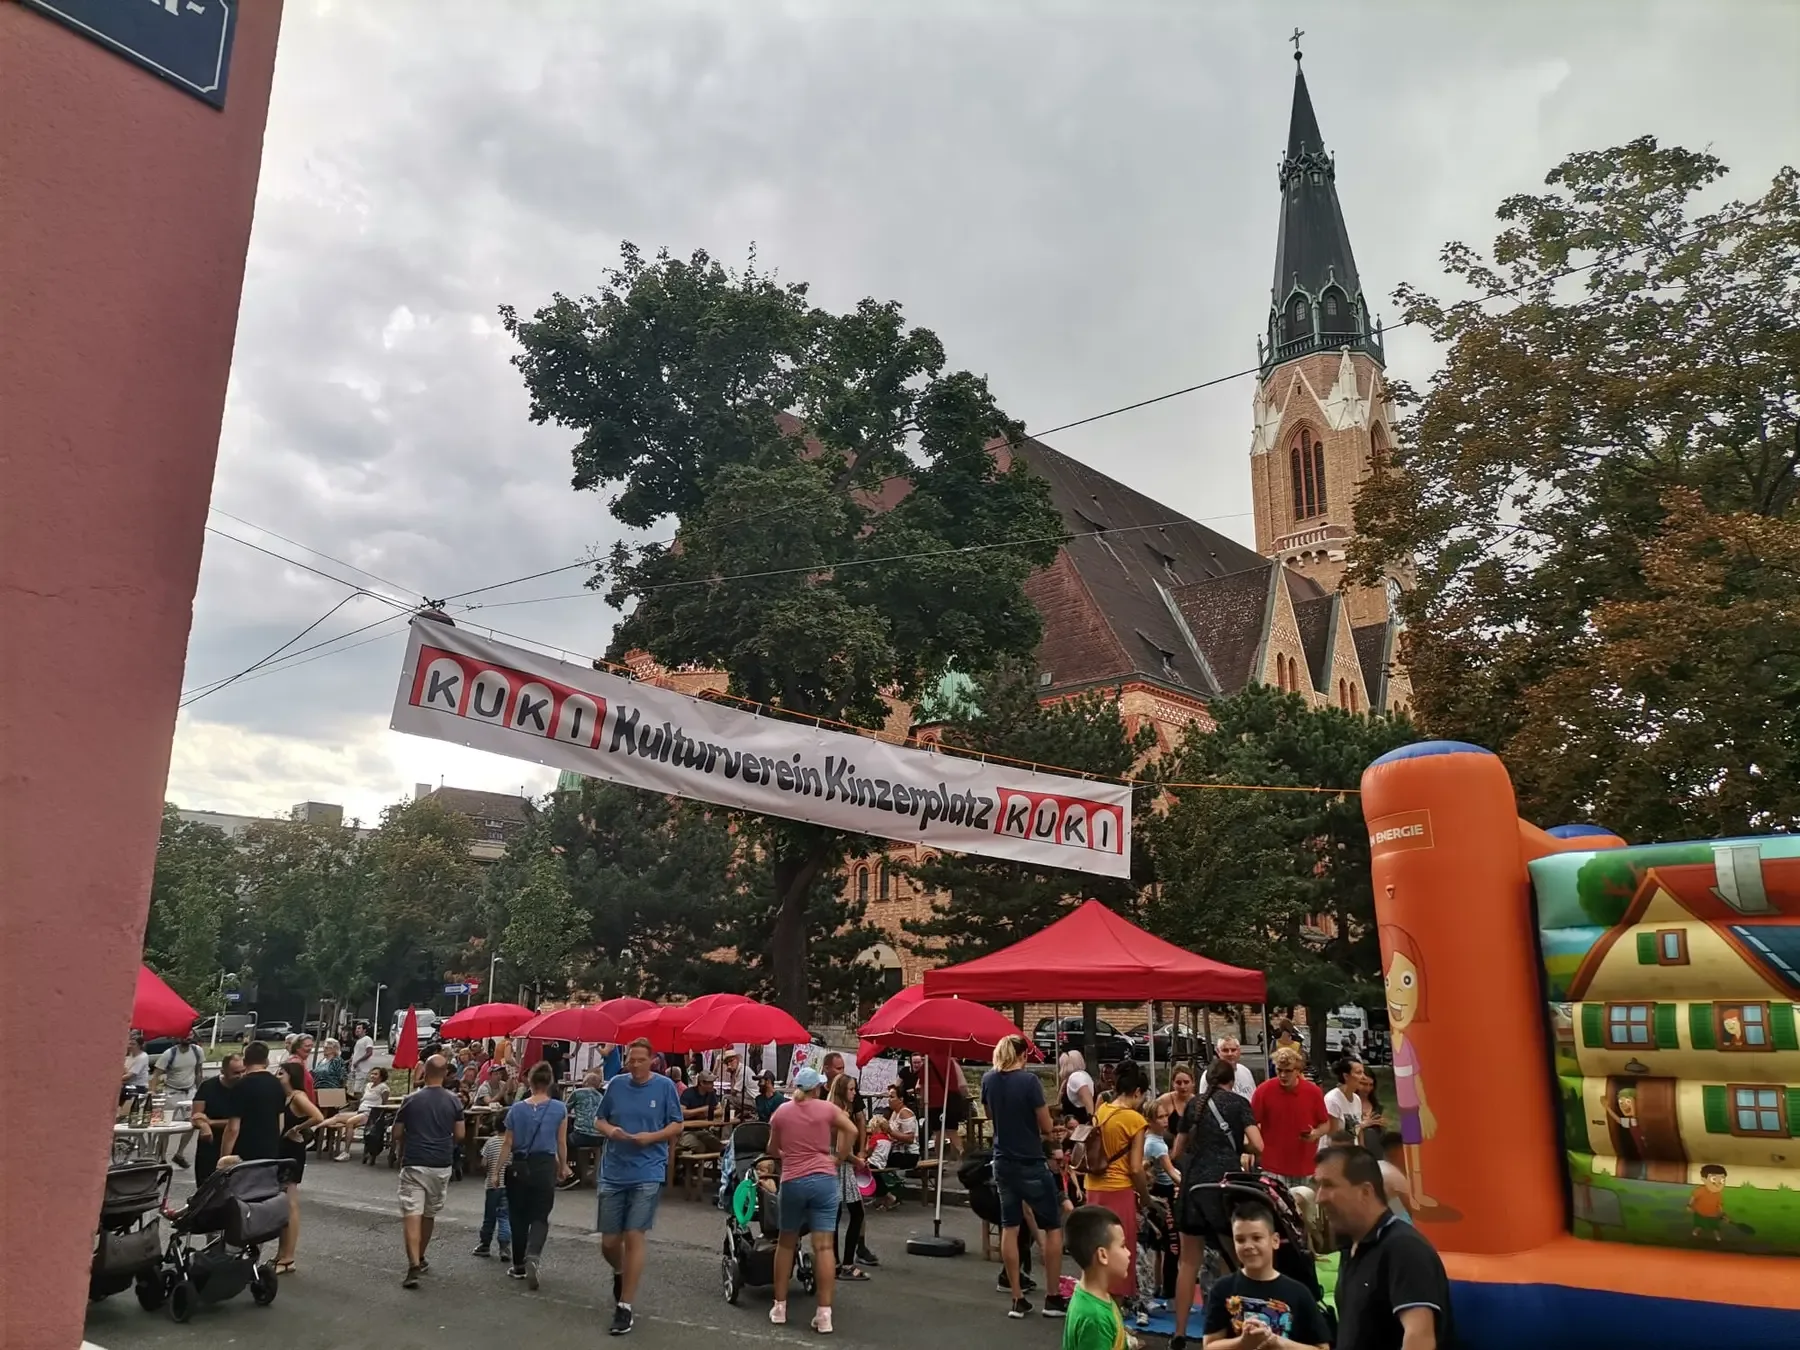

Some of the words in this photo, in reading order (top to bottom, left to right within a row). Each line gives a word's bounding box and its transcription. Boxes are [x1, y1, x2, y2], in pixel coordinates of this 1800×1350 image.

[426, 669, 584, 740] KUKI
[1005, 803, 1109, 848] KUKI
[1375, 824, 1424, 844] ENERGIE
